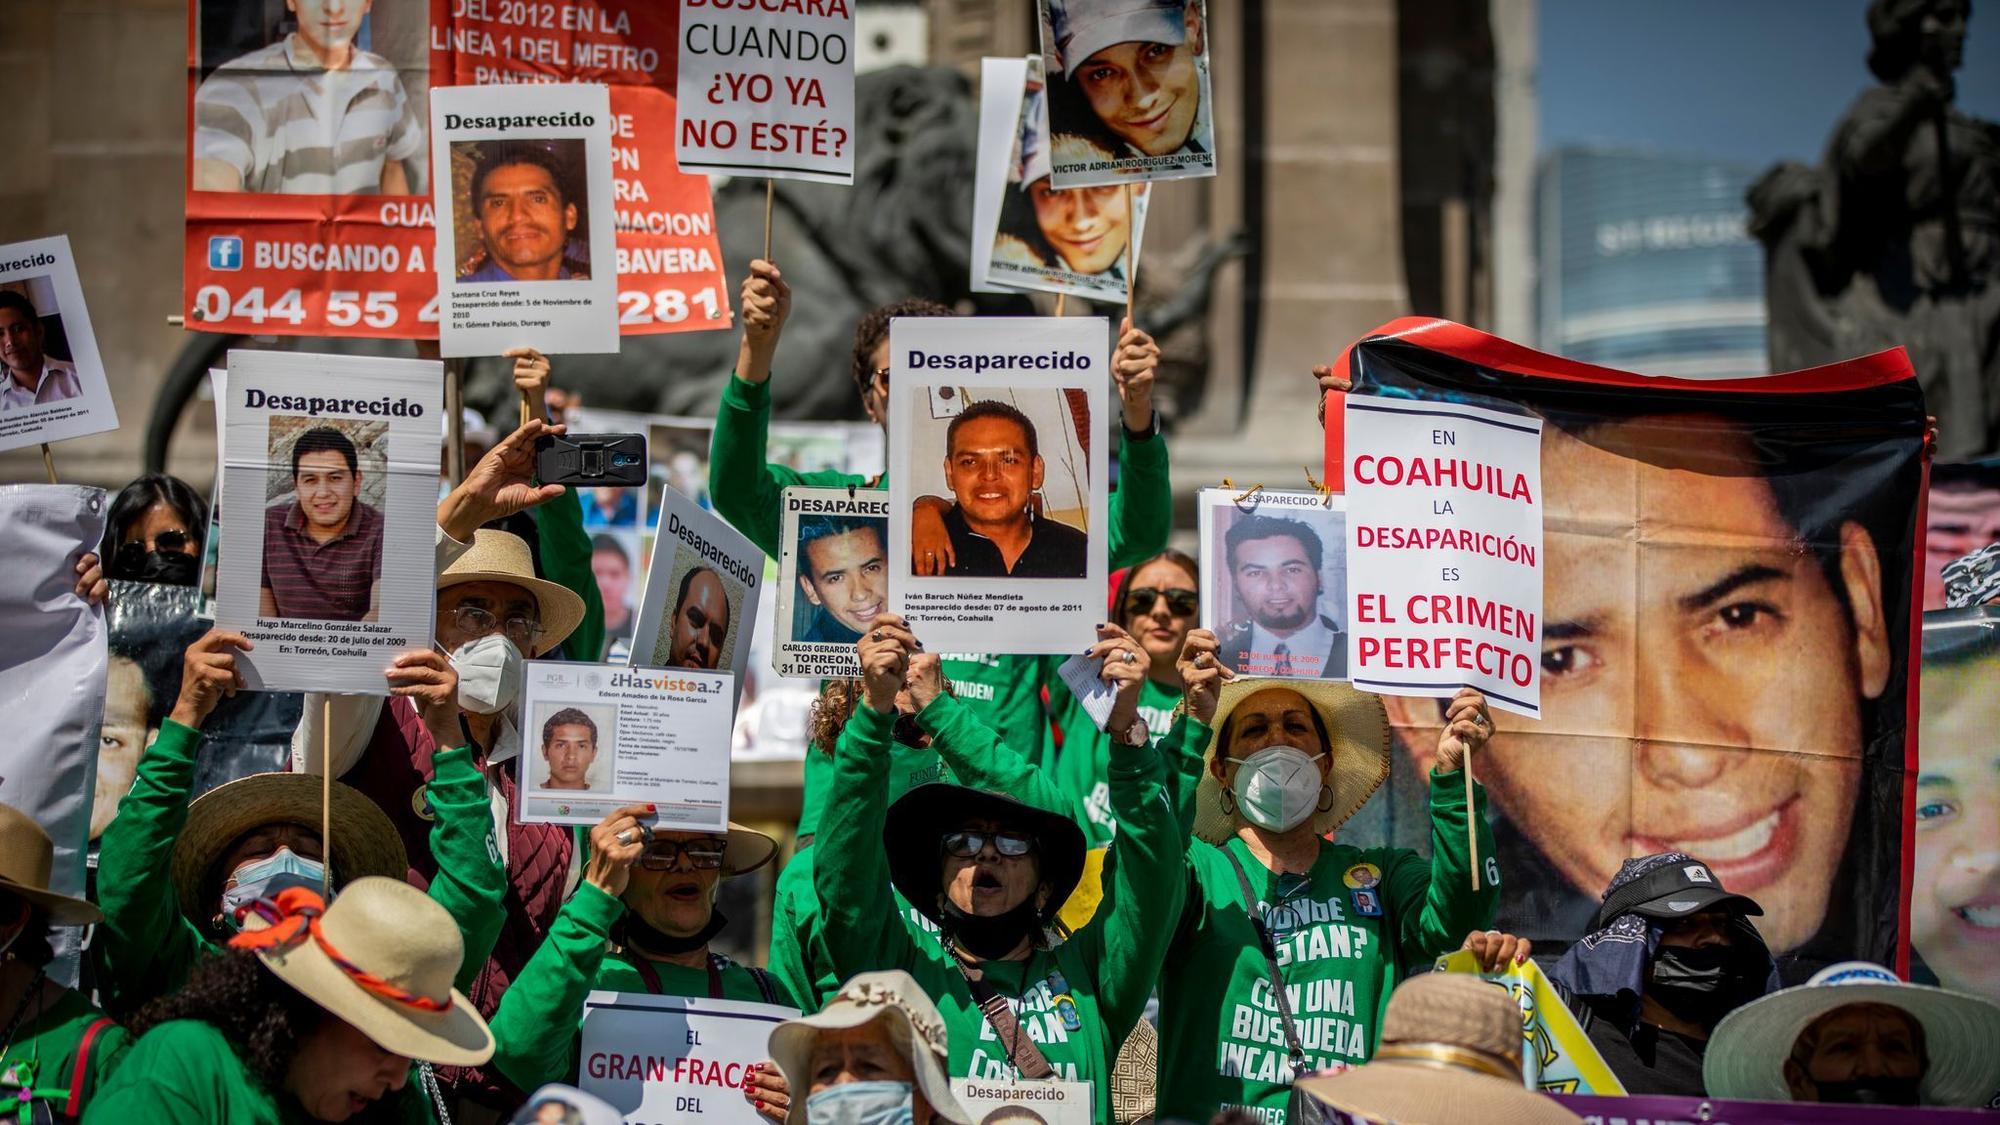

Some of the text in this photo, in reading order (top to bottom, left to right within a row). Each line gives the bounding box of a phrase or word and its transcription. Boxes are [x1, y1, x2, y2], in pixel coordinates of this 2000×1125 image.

[452, 0, 631, 35] DEL 2012 EN LA
[686, 23, 847, 65] CUANDO
[502, 36, 513, 60] 1
[520, 36, 567, 65] DEL
[572, 42, 659, 72] METRO
[707, 72, 826, 108] ¿YO YA
[445, 112, 595, 131] Desaparecido
[682, 119, 847, 157] NO ESTÉ?
[1053, 163, 1087, 174] VICTOR
[1089, 160, 1123, 171] ADRIAN
[0, 253, 56, 274] arecido
[254, 241, 400, 272] BUSCANDO
[406, 246, 426, 272] A
[616, 248, 716, 274] BAVERA
[452, 290, 520, 299] Santana Cruz Reyes
[196, 285, 307, 326] 044
[326, 291, 399, 328] 55
[617, 288, 720, 325] 281
[452, 301, 500, 310] Desaparecido
[520, 319, 551, 328] Durango
[908, 350, 1091, 374] Desaparecido
[245, 389, 424, 418] Desaparecido
[1432, 430, 1455, 446] EN
[1354, 455, 1532, 504] COAHUILA
[789, 499, 889, 514] DESAPAREC
[1433, 500, 1454, 515] LA
[669, 513, 756, 588] Desaparecido
[1357, 526, 1535, 567] DESAPARICIÓN
[1442, 567, 1460, 581] ES
[957, 592, 983, 600] Núñez
[985, 593, 1023, 601] Mendieta
[905, 604, 961, 612] Desaparecido
[1019, 605, 1047, 613] agosto
[1062, 604, 1082, 612] 2011
[257, 619, 392, 633] Hugo Marcelino González Salazar
[920, 614, 955, 622] Torreón,
[957, 614, 993, 622] Coahuila
[1357, 594, 1535, 642] EL CRIMEN
[240, 631, 406, 647] Desaparecido desde: 20 de julio del 2009
[279, 645, 367, 657] En: Torreón, Coahuila
[782, 643, 812, 653] CARLOS
[814, 645, 850, 654] GERARDO
[794, 653, 857, 666] TORREON,
[1359, 637, 1532, 687] PERFECTO
[782, 664, 864, 676] 31 DE OCTUBRE
[599, 690, 620, 698] Edson
[621, 691, 648, 700] Amadeo
[659, 693, 666, 701] la
[667, 694, 684, 702] Rosa
[1275, 924, 1367, 966] STAN?
[1305, 978, 1354, 1016] UNA
[979, 1009, 1068, 1044] EAN
[687, 1030, 701, 1046] EL
[588, 1052, 757, 1089] GRAN FRACA
[1219, 1041, 1354, 1086] INCAN
[967, 1085, 1065, 1102] Desaparecido
[676, 1096, 703, 1113] DEL
